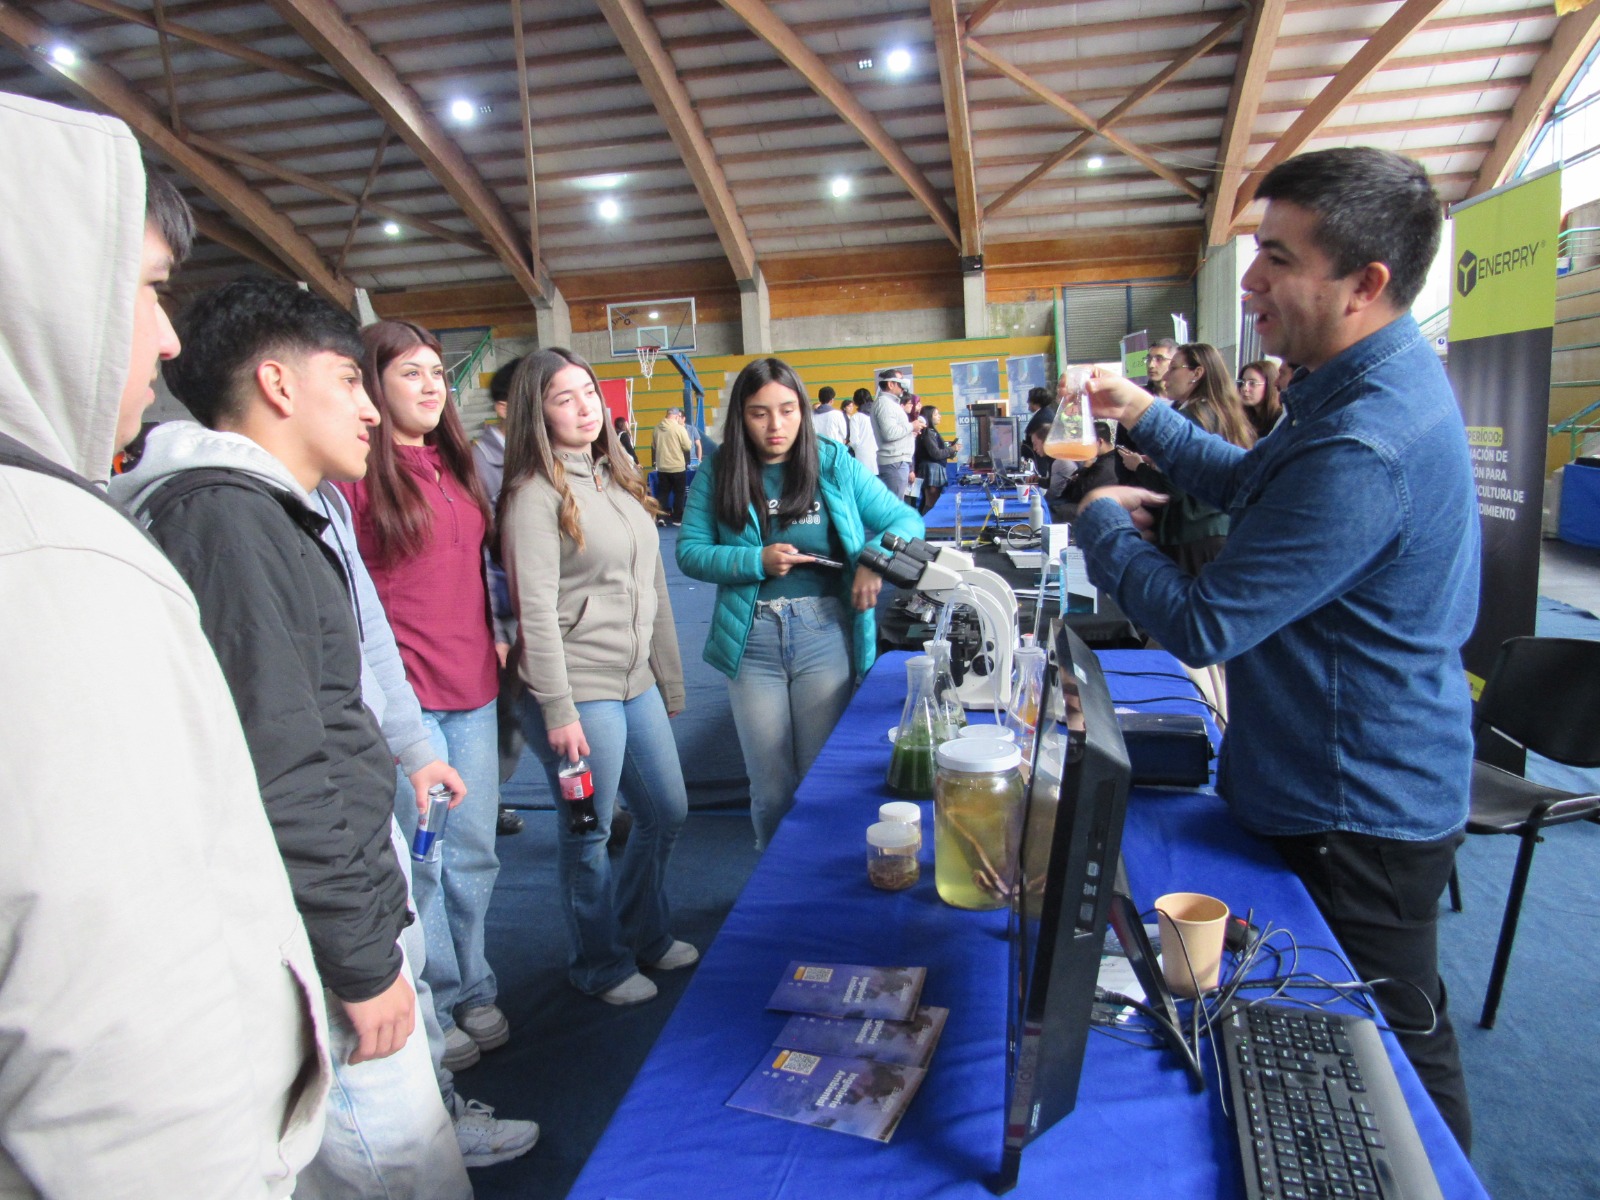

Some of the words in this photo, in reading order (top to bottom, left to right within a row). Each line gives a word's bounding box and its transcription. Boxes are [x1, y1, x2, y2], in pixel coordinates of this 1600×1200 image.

[1478, 241, 1539, 280] ENERPRY
[1470, 446, 1494, 461] ACIÓN
[1496, 450, 1508, 462] DE
[1474, 463, 1484, 478] ÓN
[1486, 468, 1507, 481] PARA
[1476, 485, 1512, 501] CULTURA
[1513, 490, 1525, 503] DE
[1478, 503, 1516, 521] DIMIENTO
[815, 1069, 847, 1107] Ambiental
